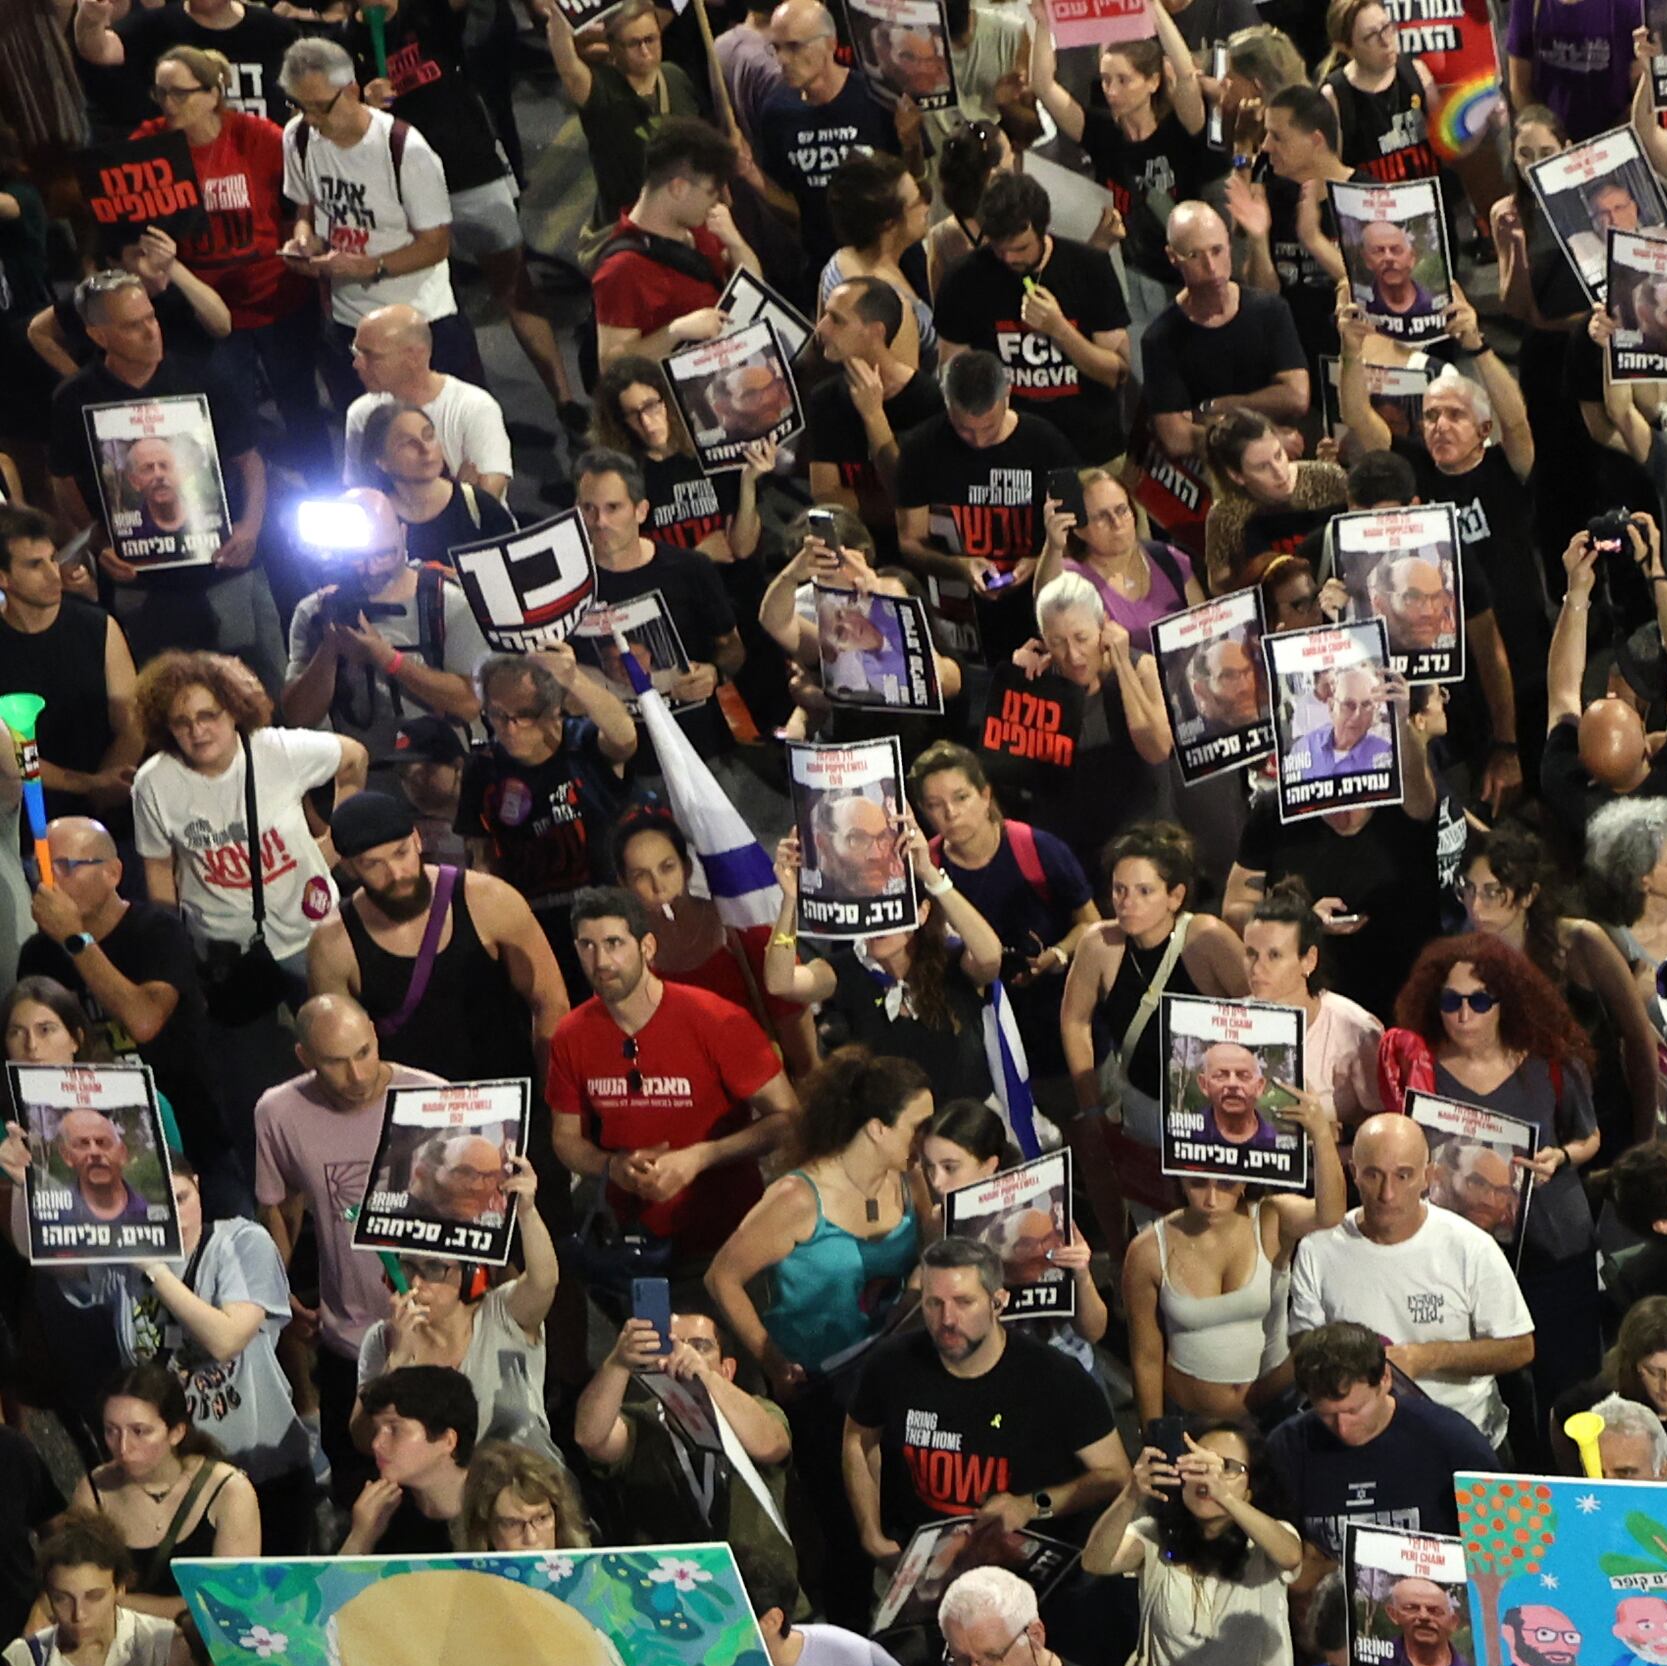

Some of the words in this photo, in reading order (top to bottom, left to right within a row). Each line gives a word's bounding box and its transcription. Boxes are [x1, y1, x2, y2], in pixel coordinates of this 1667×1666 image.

[101, 158, 174, 197] כולנו
[89, 180, 200, 223] חטופים
[457, 516, 591, 627] כן
[1408, 657, 1449, 682] נדב,
[1003, 688, 1061, 731] כולנו
[984, 715, 1075, 768] חטופים
[1284, 781, 1335, 807] סליחה!
[1337, 773, 1391, 802] עמירם,
[1174, 1139, 1238, 1166] סליחה!
[1243, 1143, 1290, 1172] חיים,
[42, 1224, 113, 1249] סליחה!
[117, 1225, 167, 1251] חיים,
[365, 1217, 443, 1243] סליחה!
[444, 1229, 494, 1254] נדב,
[1017, 1287, 1057, 1309] נדב,
[907, 1408, 939, 1429] BRING
[904, 1427, 931, 1447] THEM
[931, 1431, 963, 1451] HOME
